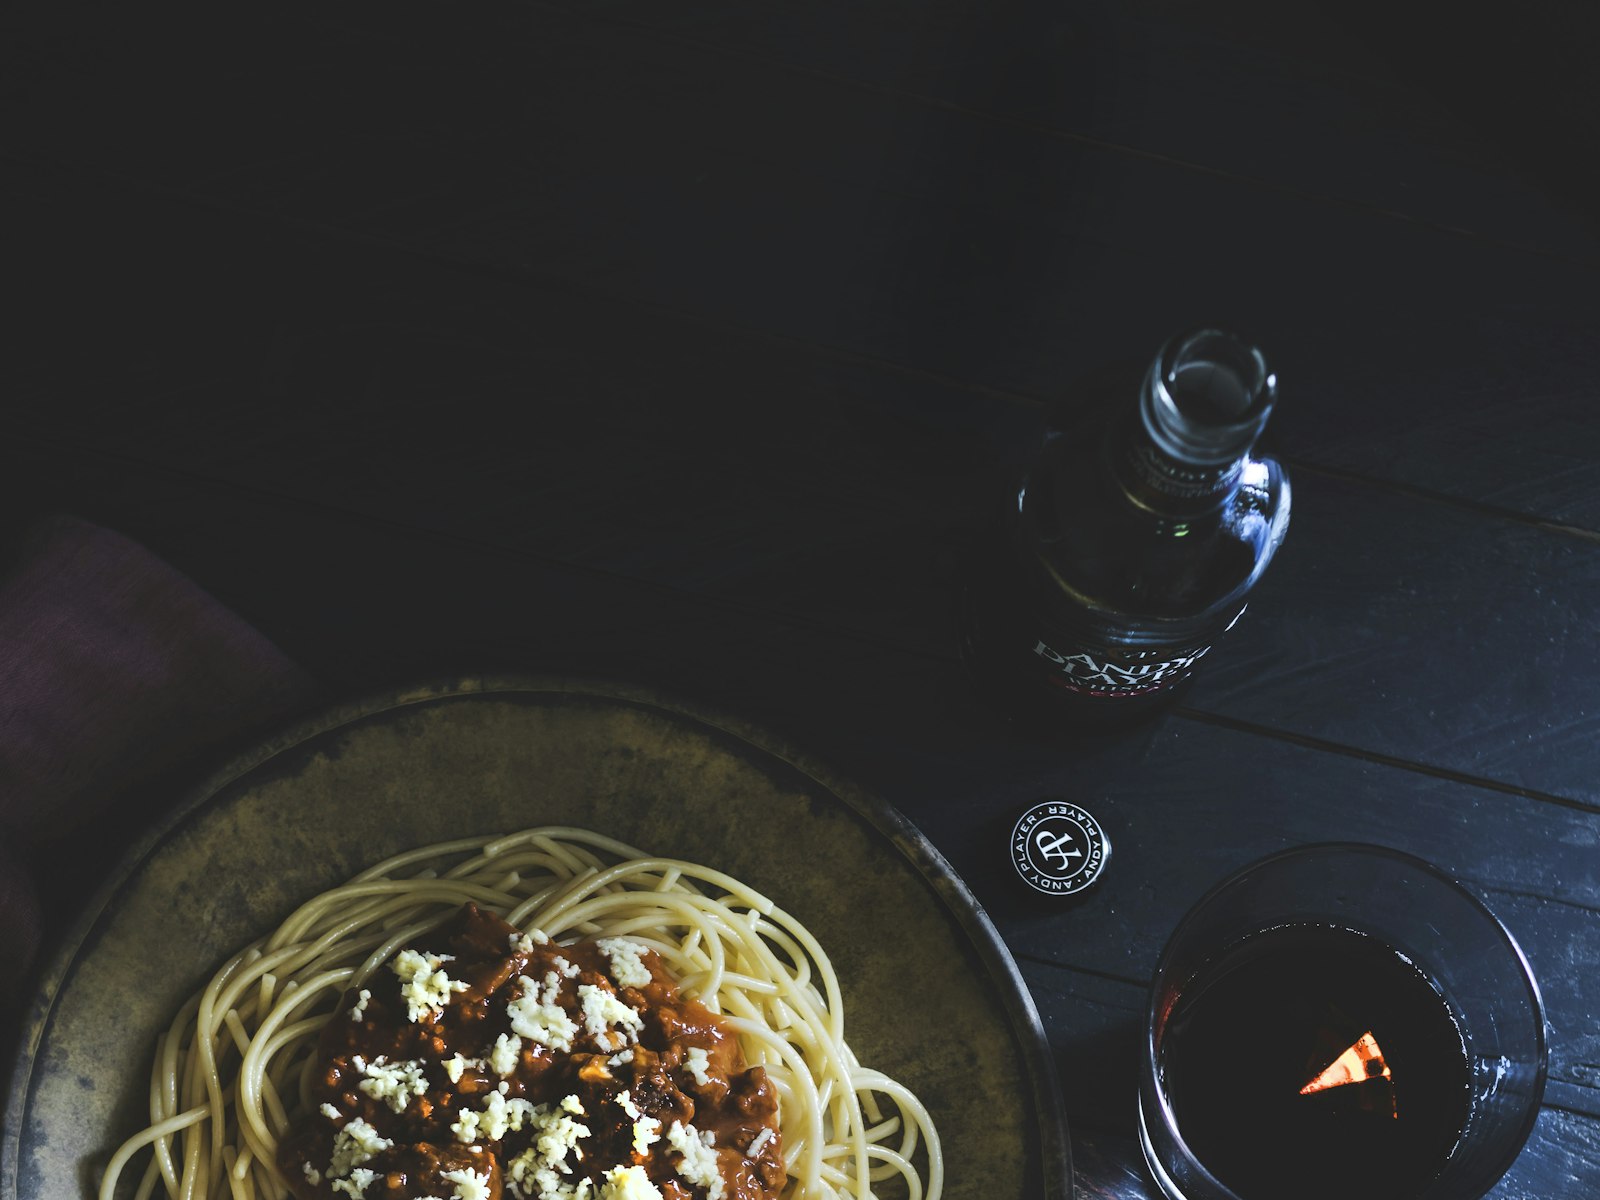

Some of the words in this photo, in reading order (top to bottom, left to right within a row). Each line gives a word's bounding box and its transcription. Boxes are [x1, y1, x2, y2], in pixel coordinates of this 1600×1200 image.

[1048, 806, 1098, 837] PLAYER
[1016, 815, 1037, 872] PLAYER
[1084, 840, 1101, 878] ANDY
[1030, 874, 1073, 890] ANDY
